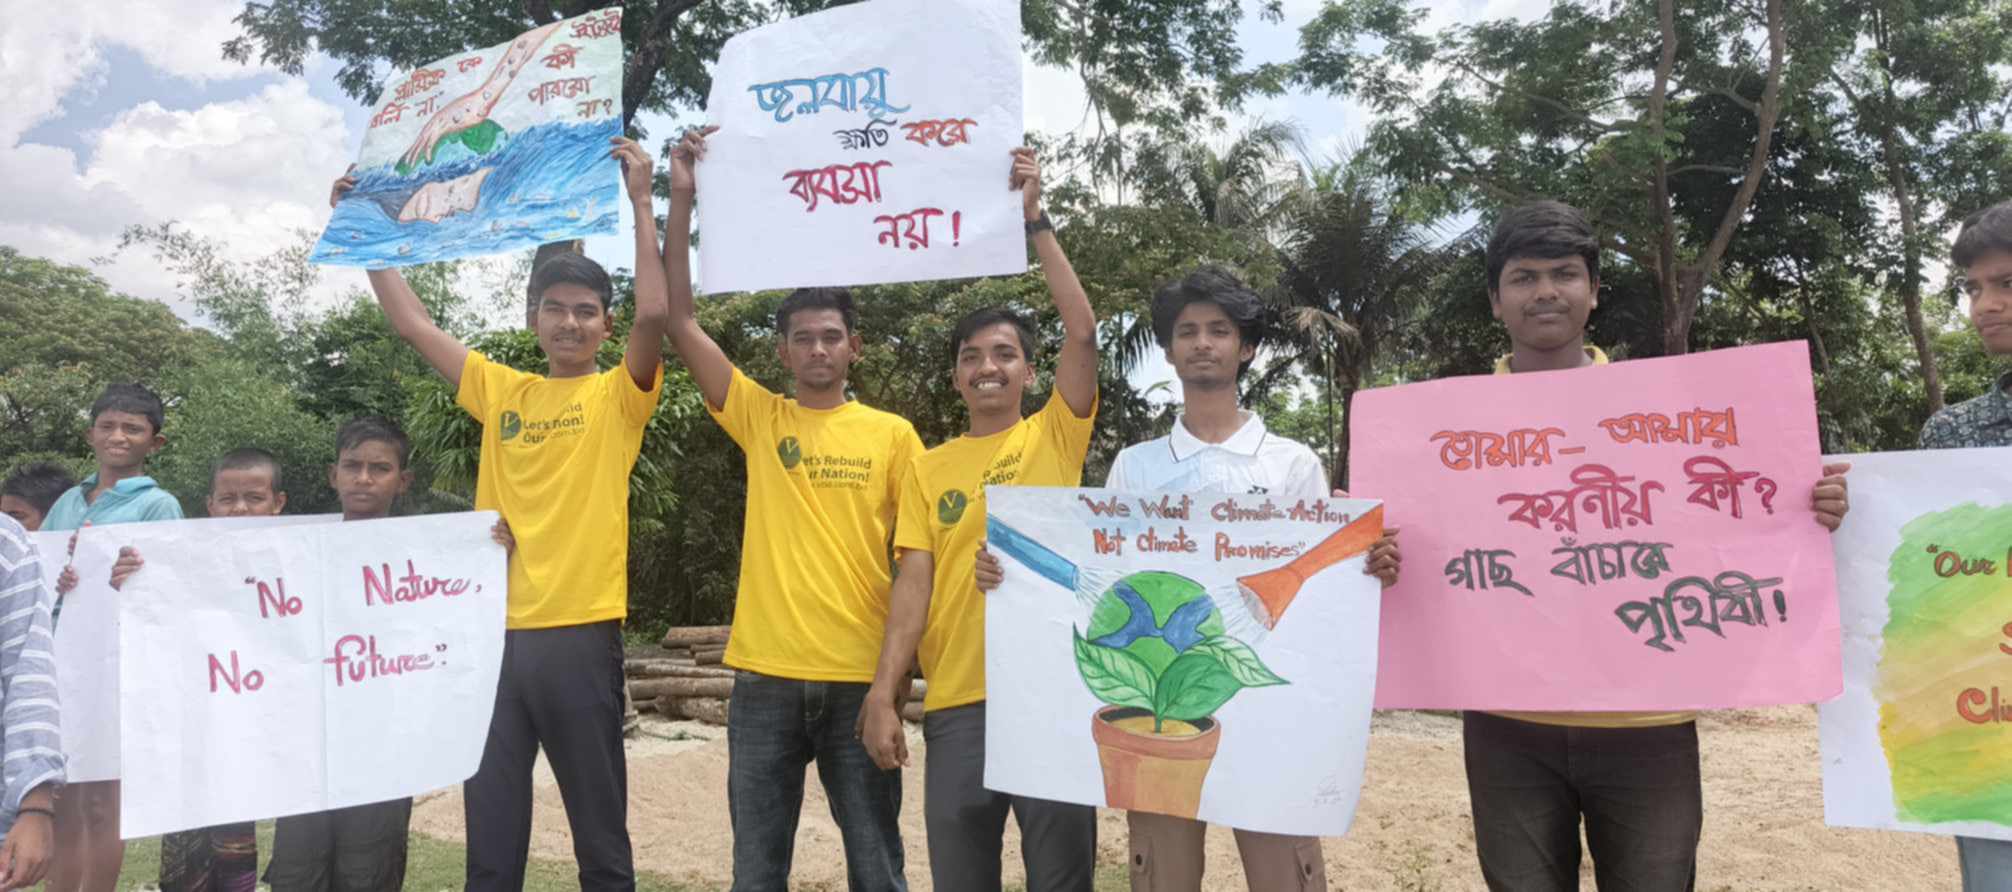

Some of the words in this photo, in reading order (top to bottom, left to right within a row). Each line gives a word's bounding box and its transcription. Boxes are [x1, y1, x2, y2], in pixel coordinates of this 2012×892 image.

[540, 43, 585, 70] কী
[747, 67, 911, 122] জলবায়ু
[833, 119, 898, 150] ক্ষতি
[900, 118, 978, 147] করে
[782, 160, 893, 212] ব্যবসা
[802, 454, 822, 466] et's
[823, 456, 872, 470] Rebuild
[820, 467, 870, 483] Nation!
[1137, 494, 1194, 521] Want
[1210, 498, 1286, 523] Climate
[1286, 499, 1350, 523] Action
[1498, 463, 1665, 532] করণীয়
[1092, 527, 1127, 557] Not
[1136, 526, 1199, 553] Climate
[1444, 548, 1535, 597] গাছ
[207, 650, 265, 694] No
